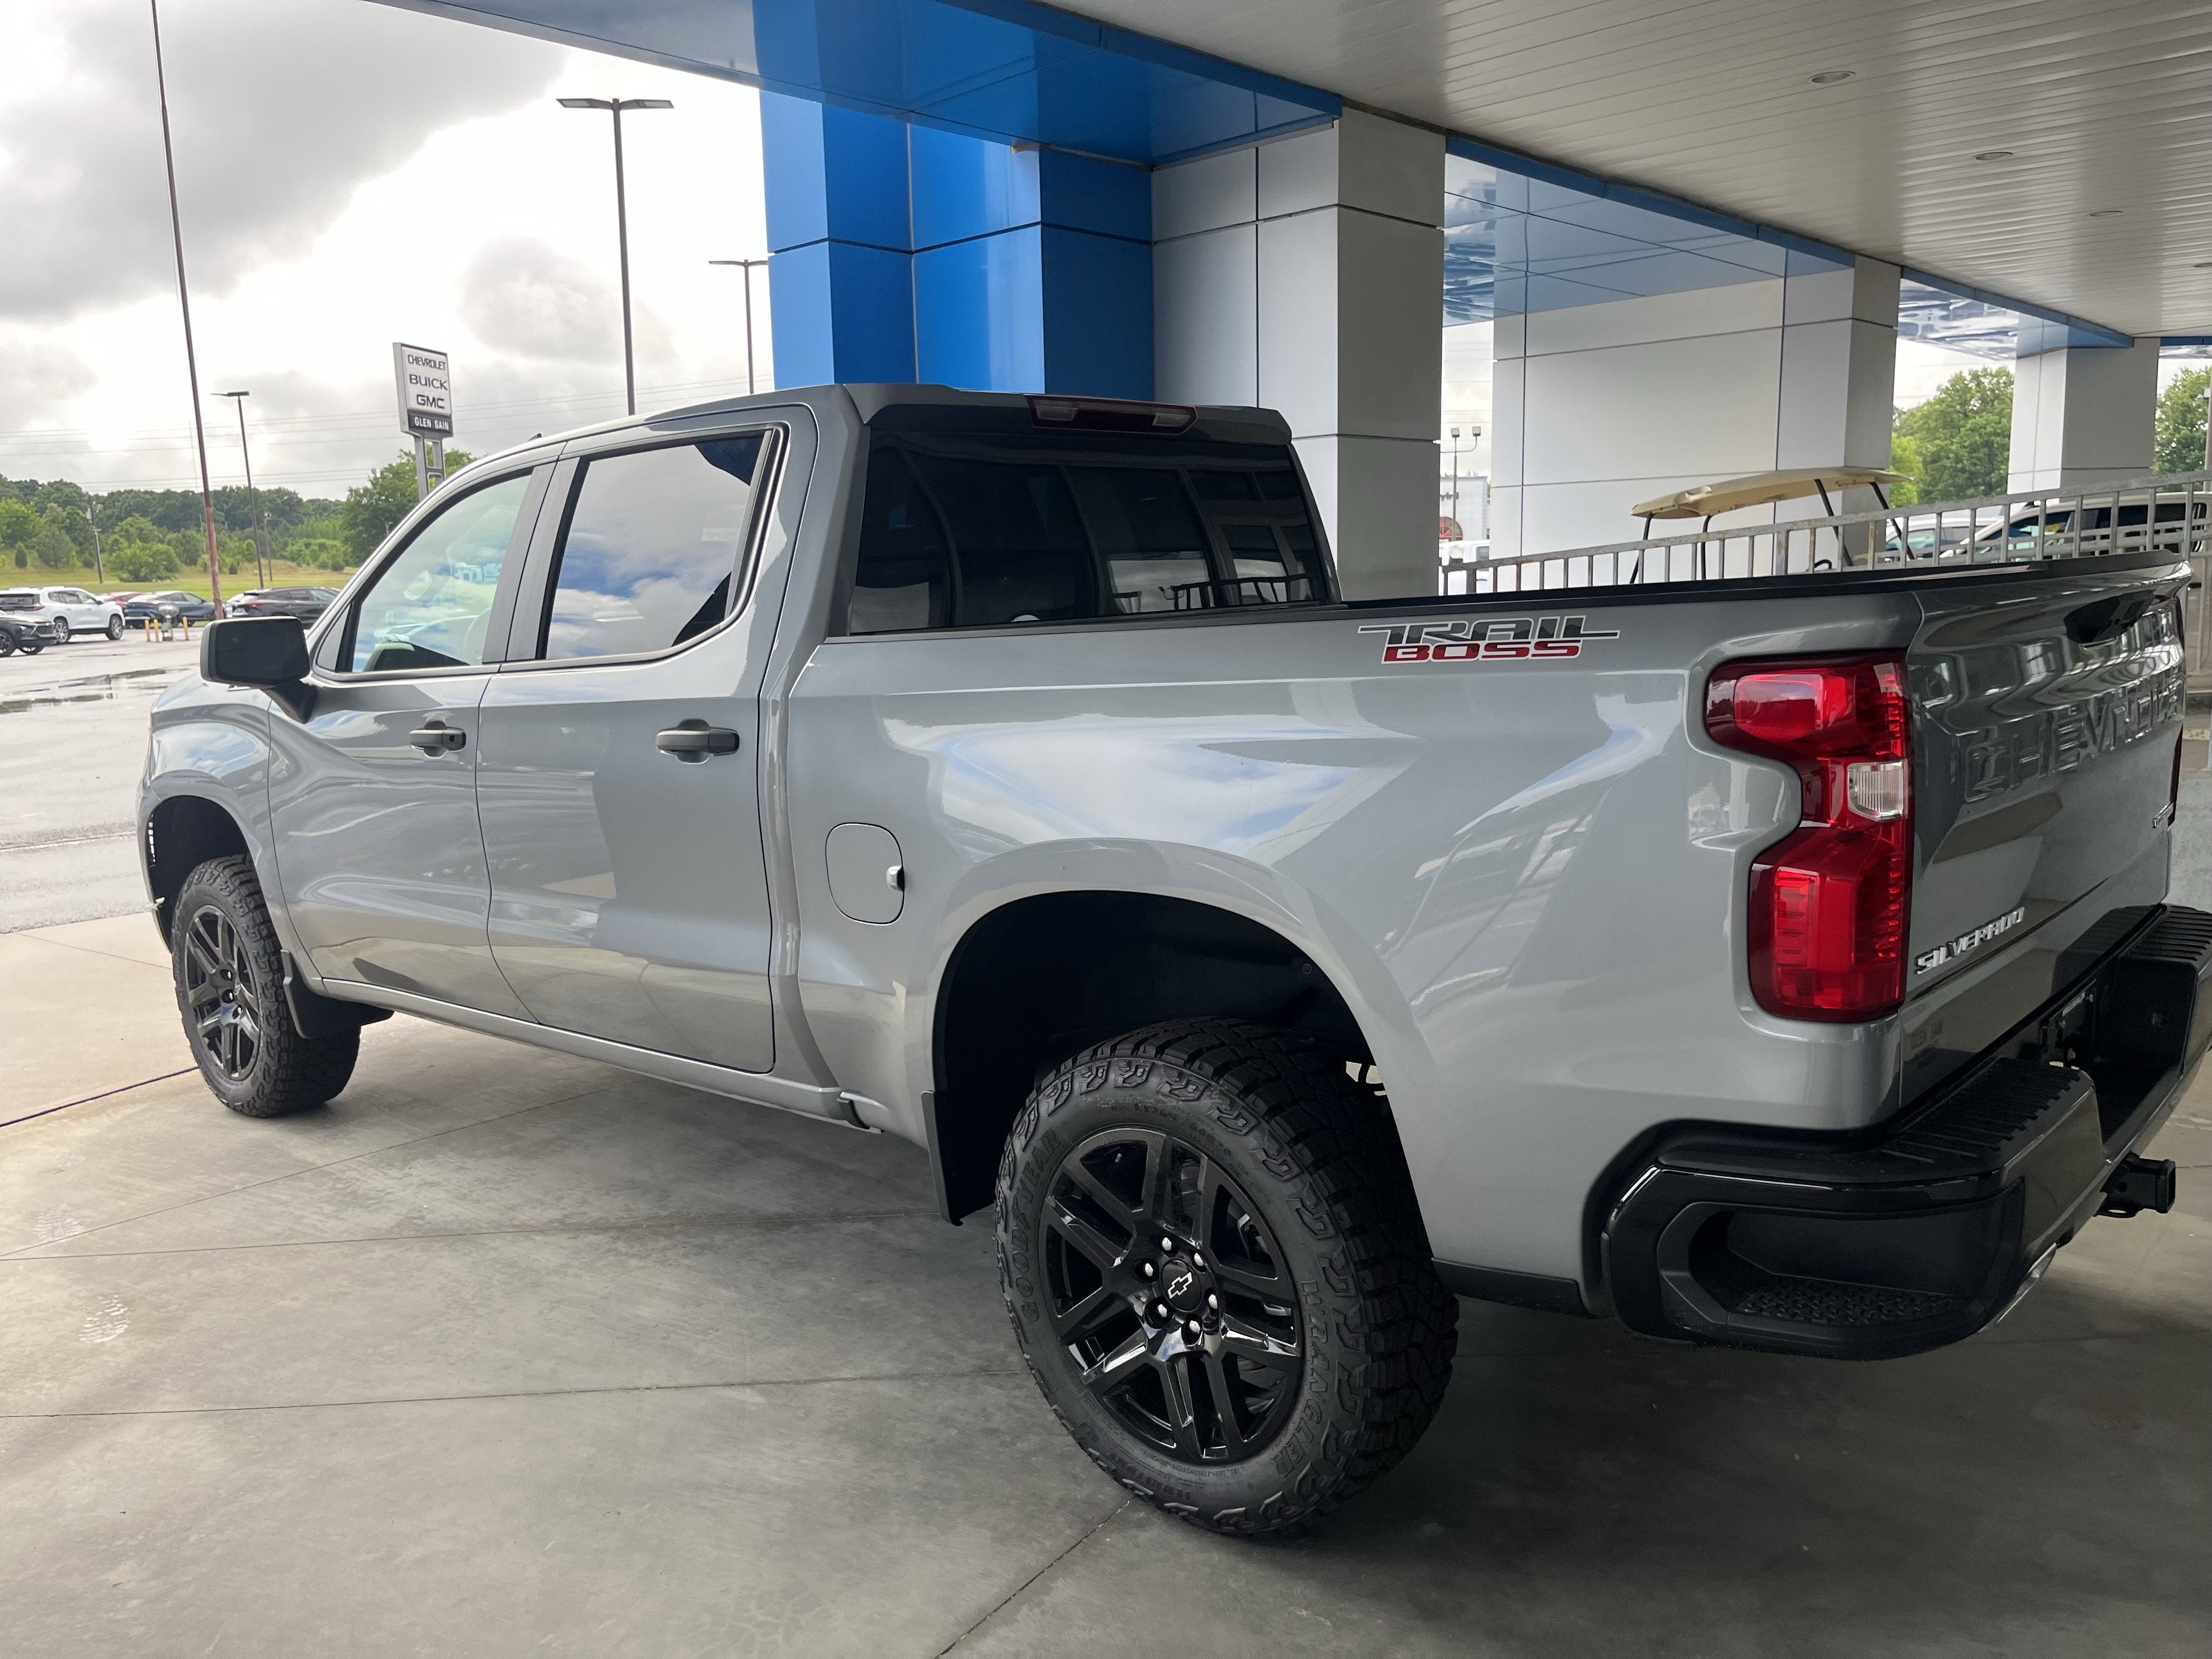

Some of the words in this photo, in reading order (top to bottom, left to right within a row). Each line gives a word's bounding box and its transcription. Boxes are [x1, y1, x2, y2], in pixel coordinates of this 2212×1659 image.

[408, 354, 445, 371] CHEVROLET
[409, 374, 448, 391] BUICK
[416, 394, 445, 409] GMC
[414, 416, 432, 428] GLEN
[435, 420, 449, 431] SAIN
[1358, 615, 1621, 645] TRAIL
[1381, 639, 1583, 664] BOSS
[1914, 906, 2025, 975] SILVERADO
[1011, 1128, 1061, 1323] GOODYEAR
[1273, 1280, 1330, 1478] WRANGLER
